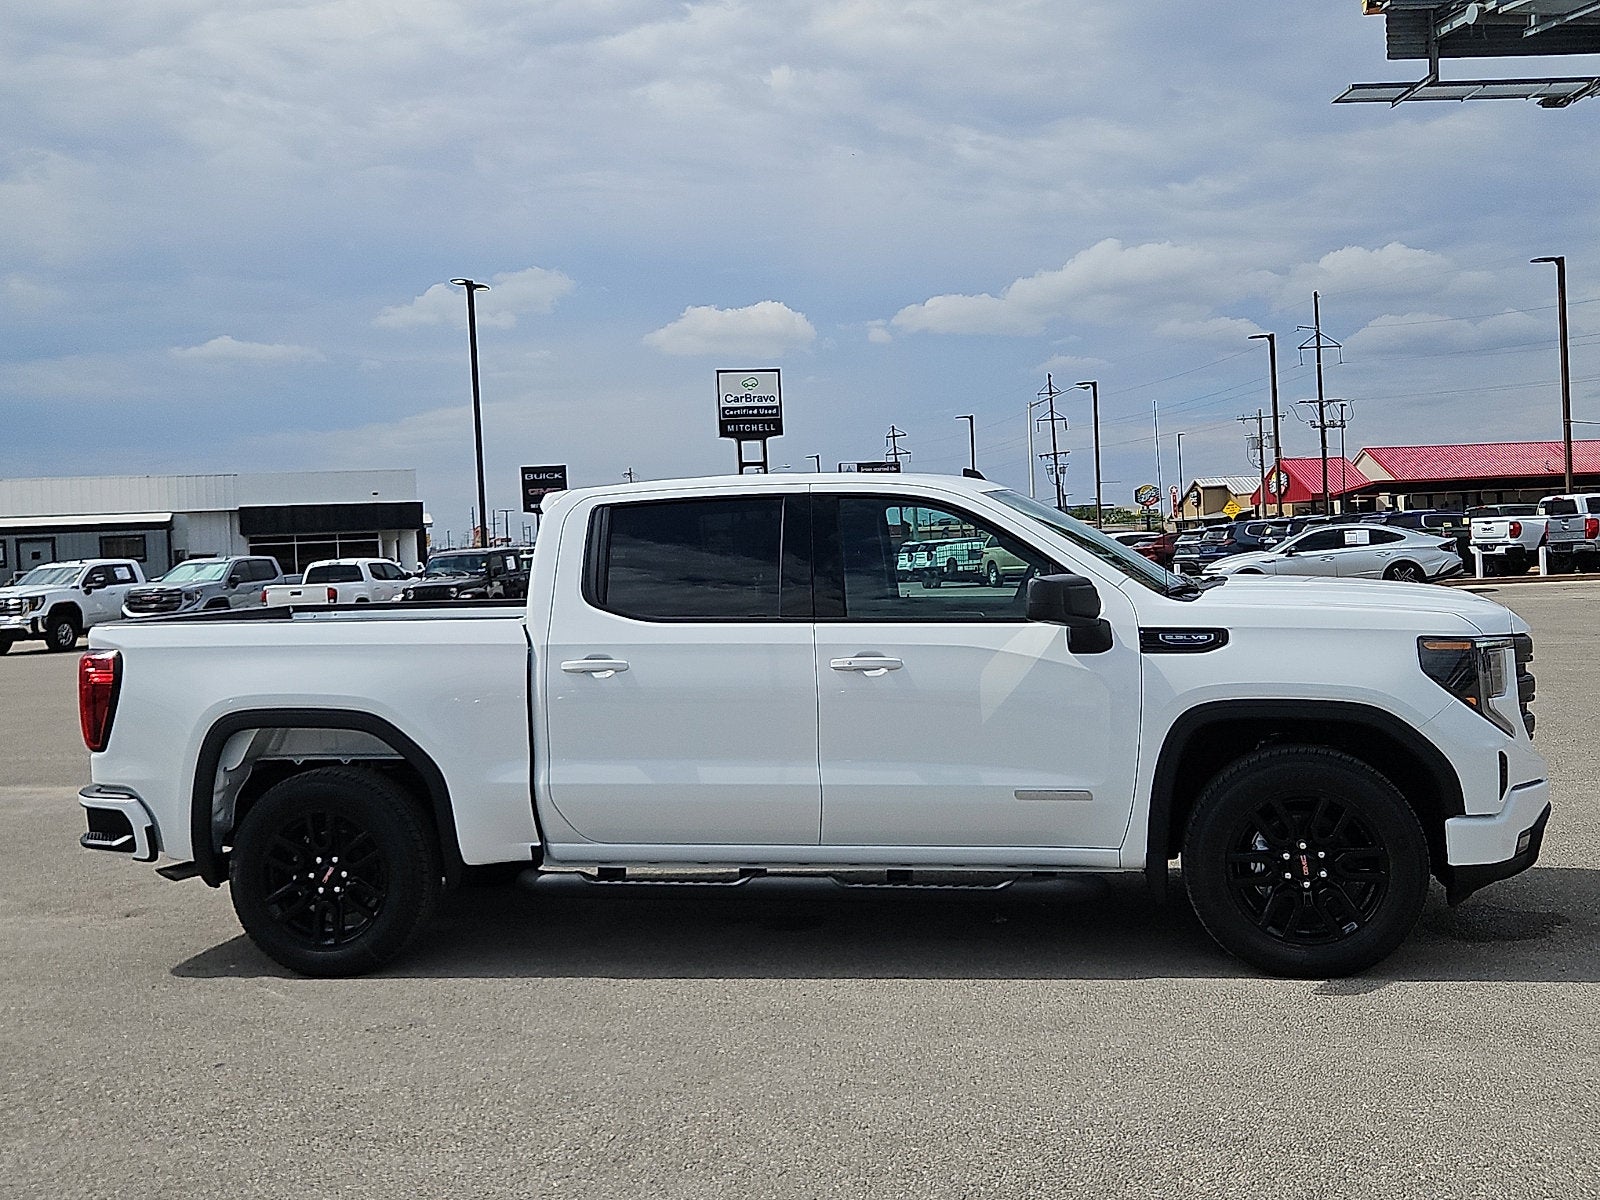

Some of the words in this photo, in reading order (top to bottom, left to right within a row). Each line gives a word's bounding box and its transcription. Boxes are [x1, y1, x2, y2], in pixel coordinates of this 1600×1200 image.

[724, 393, 776, 403] CarBravo
[727, 423, 776, 432] MITCHELL
[524, 472, 563, 480] BUICK
